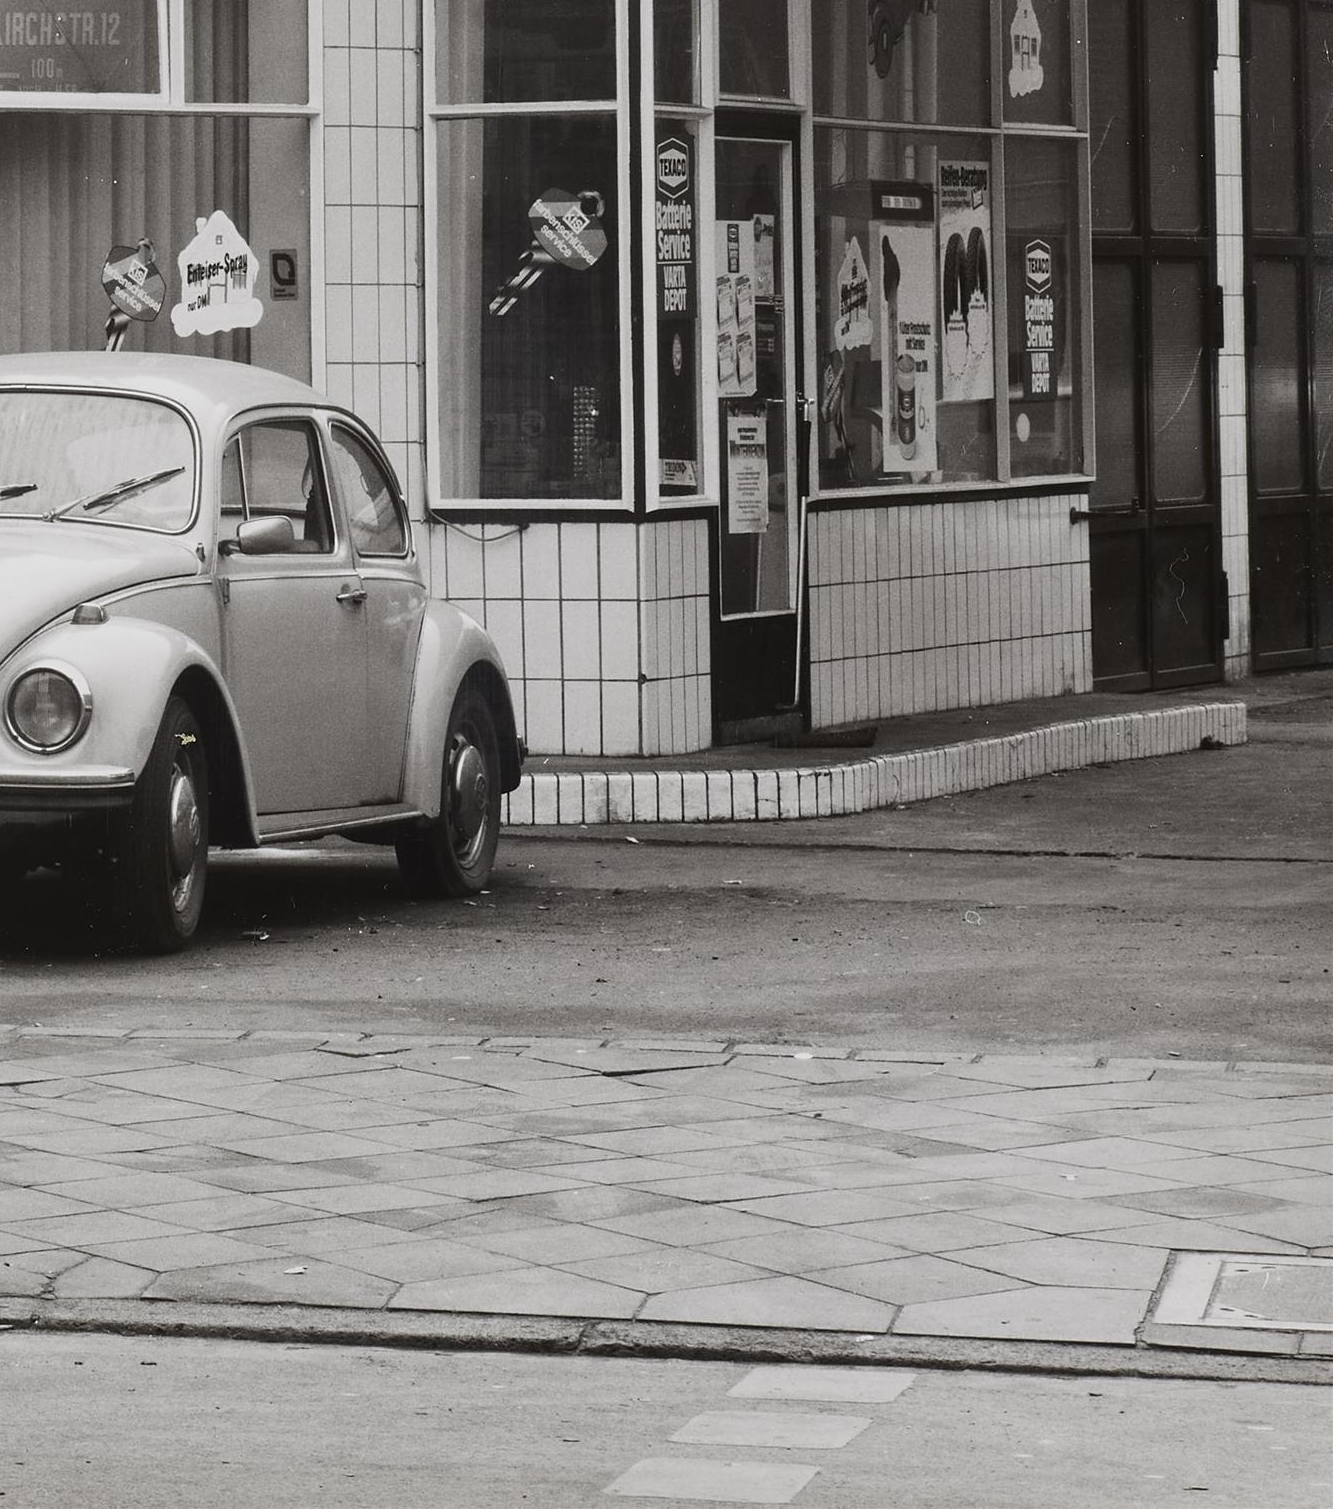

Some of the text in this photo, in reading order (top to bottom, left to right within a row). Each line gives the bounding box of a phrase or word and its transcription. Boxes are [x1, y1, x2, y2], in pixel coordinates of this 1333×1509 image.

[659, 158, 686, 177] TEXACO
[655, 199, 692, 230] Batterie
[532, 198, 598, 266] farbenschlüssel
[540, 224, 573, 258] service
[657, 229, 691, 260] Service
[663, 265, 687, 288] VARTA
[187, 299, 197, 312] nur
[664, 288, 687, 312] DEPOT
